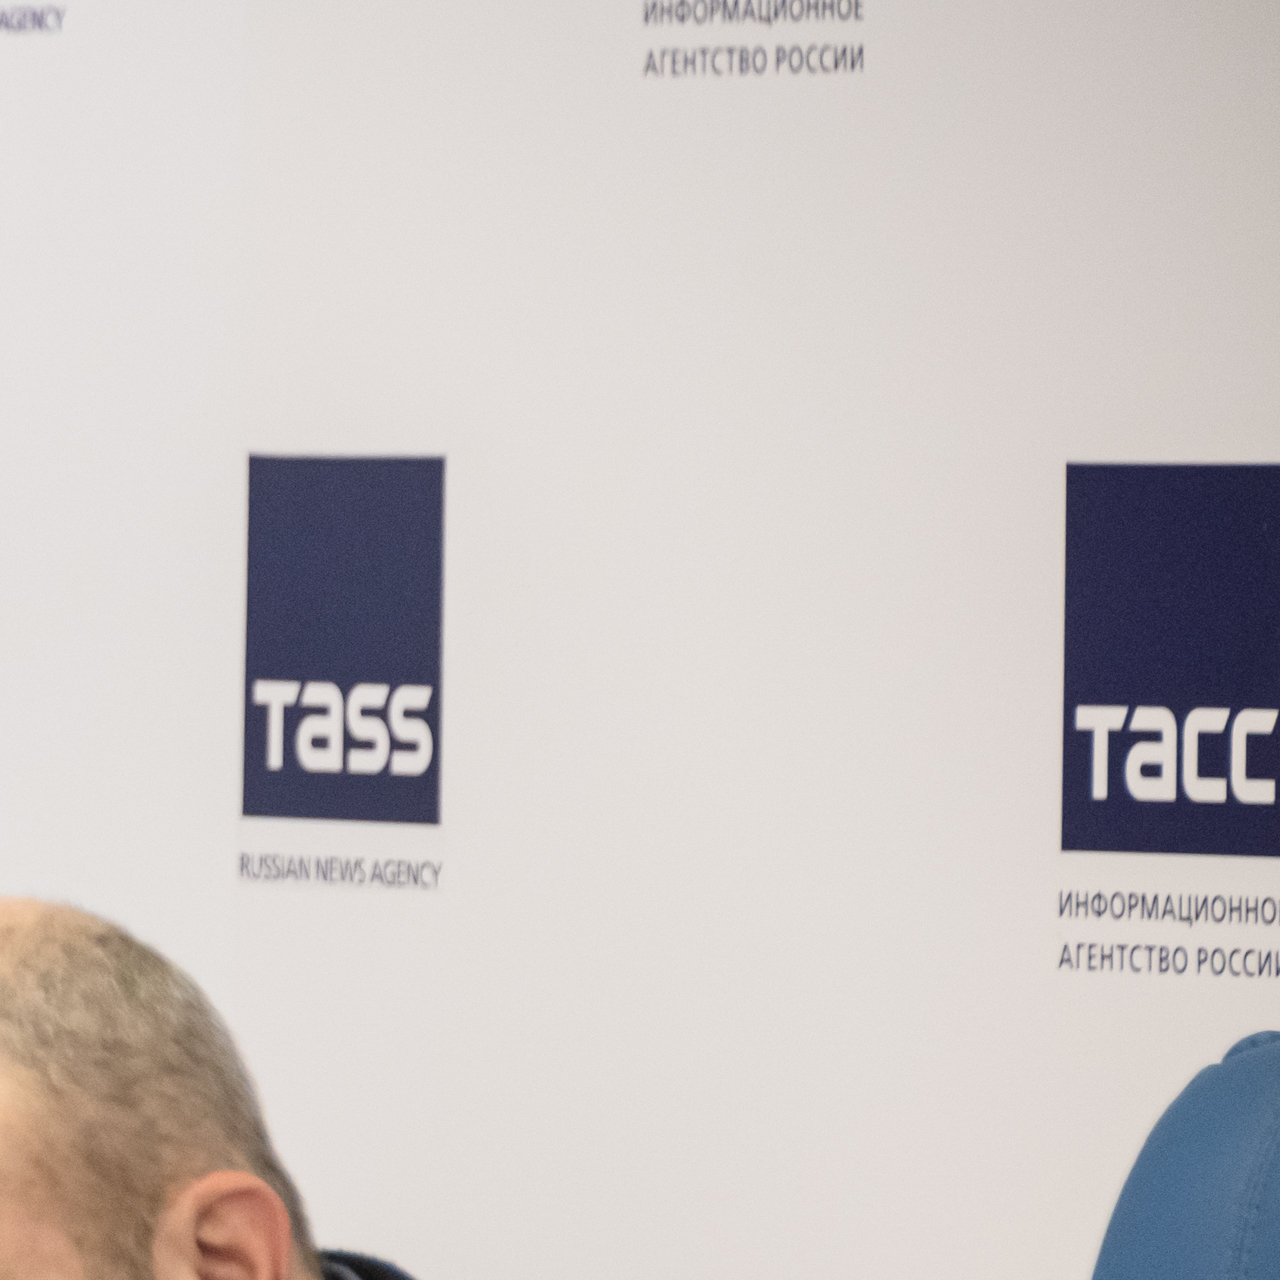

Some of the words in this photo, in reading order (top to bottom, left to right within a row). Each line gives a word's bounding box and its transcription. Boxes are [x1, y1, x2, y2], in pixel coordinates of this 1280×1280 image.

[643, 0, 864, 28] ИНФОРМАЦИОННОЕ
[643, 46, 768, 79] АГЕНТСТВО
[775, 43, 865, 75] РОССИИ
[240, 854, 311, 882] RUSSIAN
[316, 857, 366, 884] NEWS
[370, 859, 442, 888] AGENCY
[1058, 889, 1280, 928] ИНФОРМАЦИОННО
[1058, 942, 1188, 974] АГЕНТСТВО
